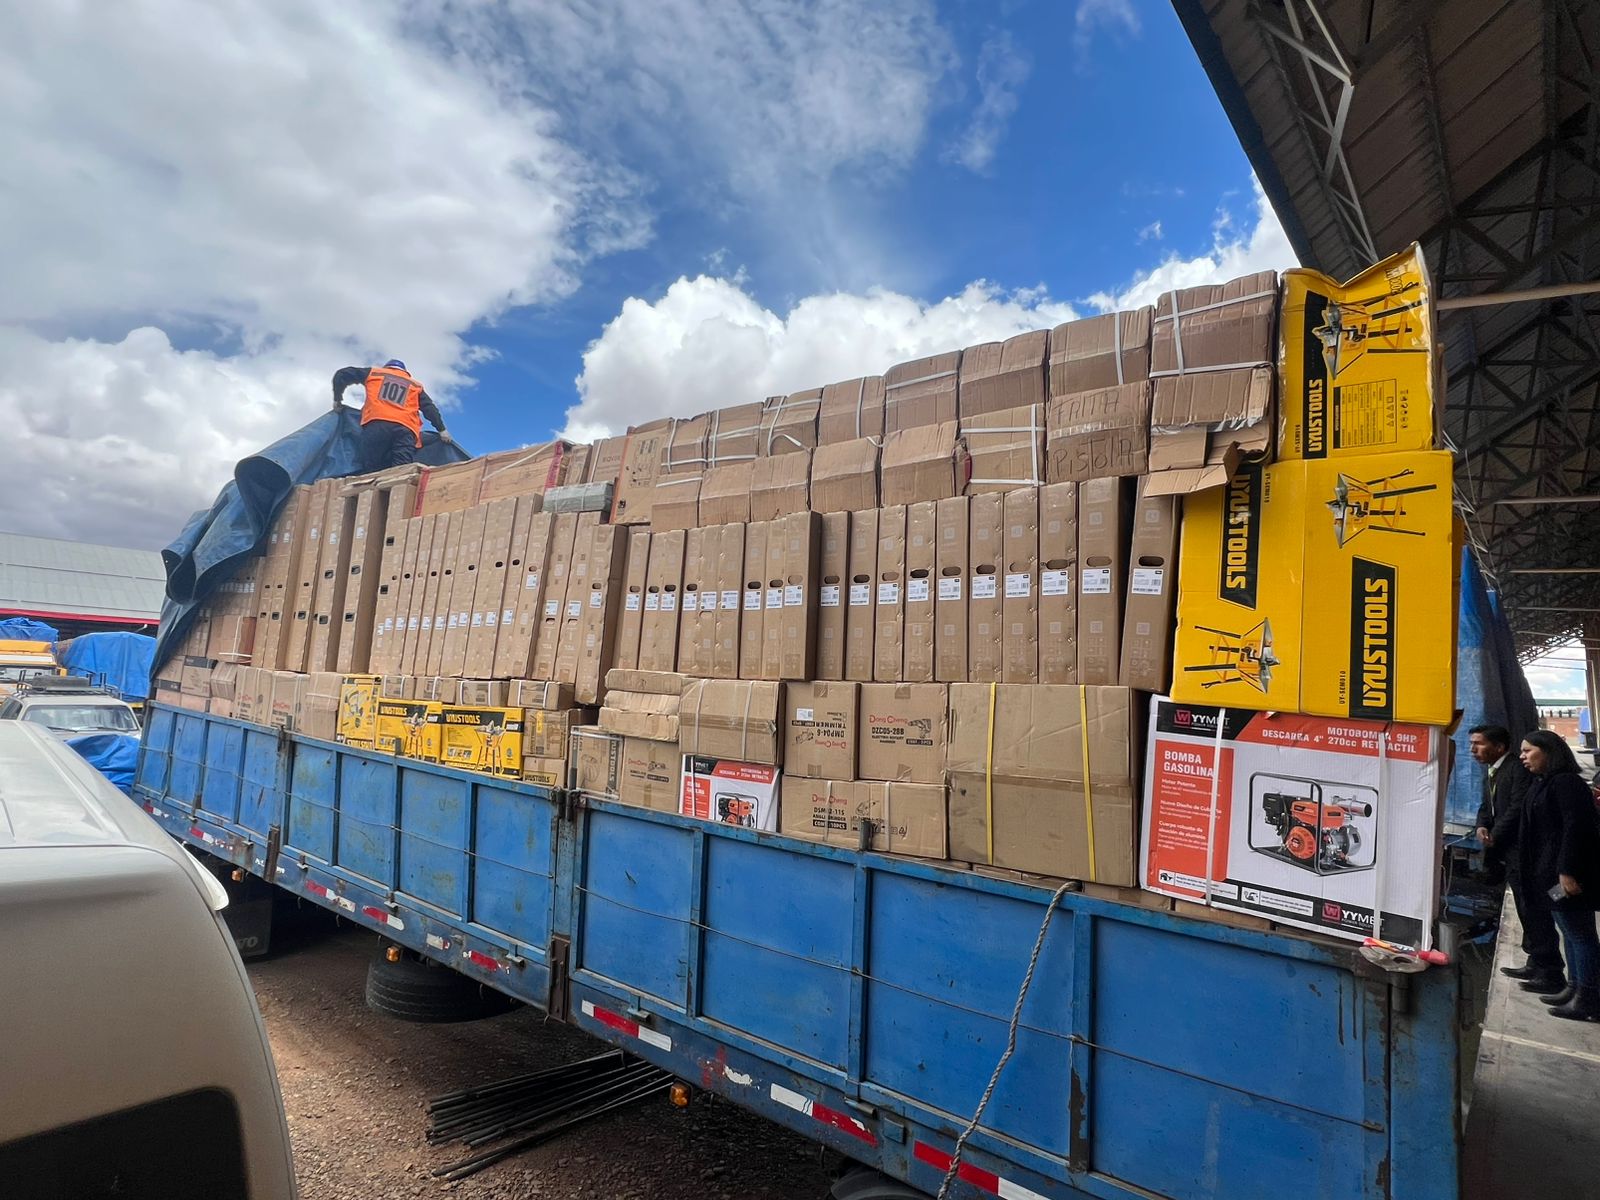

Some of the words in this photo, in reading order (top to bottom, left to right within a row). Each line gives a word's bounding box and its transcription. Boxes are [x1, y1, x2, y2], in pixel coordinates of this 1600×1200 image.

[382, 382, 406, 403] 107
[1308, 379, 1323, 452] UYUSTOOLS
[1226, 474, 1251, 589] UYUSTOOLS
[1362, 578, 1389, 708] UYUSTOOLS
[1191, 714, 1230, 726] YYMT
[1328, 727, 1391, 741] MOTOBOMA
[1396, 733, 1418, 743] 9HP
[1313, 735, 1324, 743] 4"
[1327, 736, 1357, 747] 270cc
[1361, 741, 1417, 754] RETACTIL
[1164, 750, 1202, 764] BOMBA
[1163, 762, 1214, 777] GASOLINA
[813, 807, 845, 815] DSM2-115
